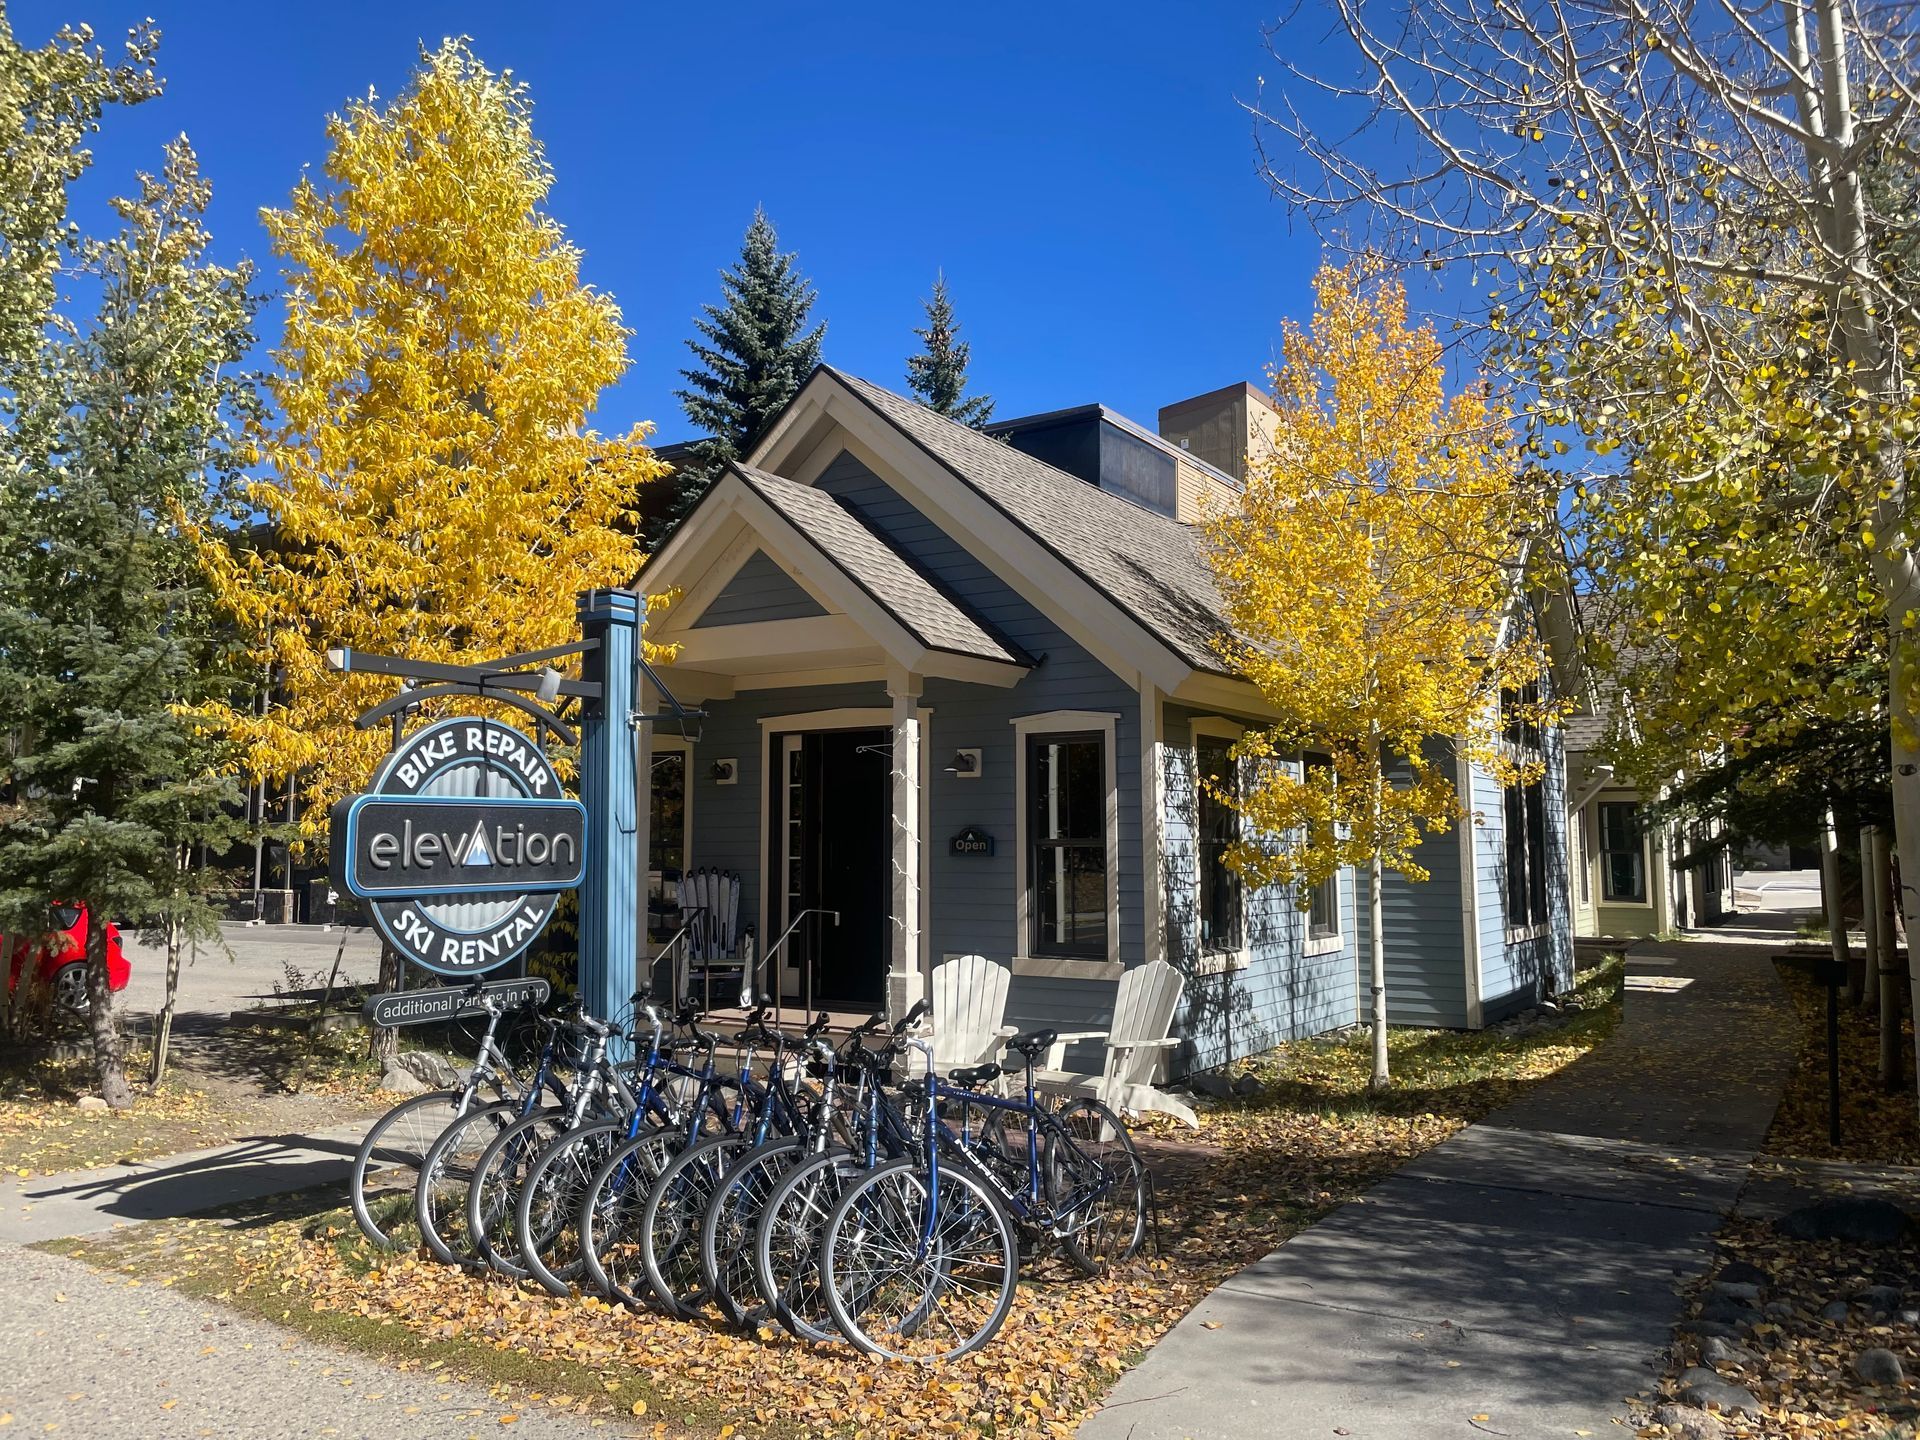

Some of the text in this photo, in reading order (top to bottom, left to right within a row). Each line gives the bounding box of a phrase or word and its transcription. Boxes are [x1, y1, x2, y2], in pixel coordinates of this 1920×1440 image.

[396, 727, 548, 795] BIKE REPAIR
[955, 839, 986, 853] Open
[393, 906, 544, 965] SKI RENTAL
[383, 996, 452, 1019] additional
[456, 992, 503, 1010] parng
[506, 988, 518, 1002] in
[954, 1138, 1014, 1200] NORCO
